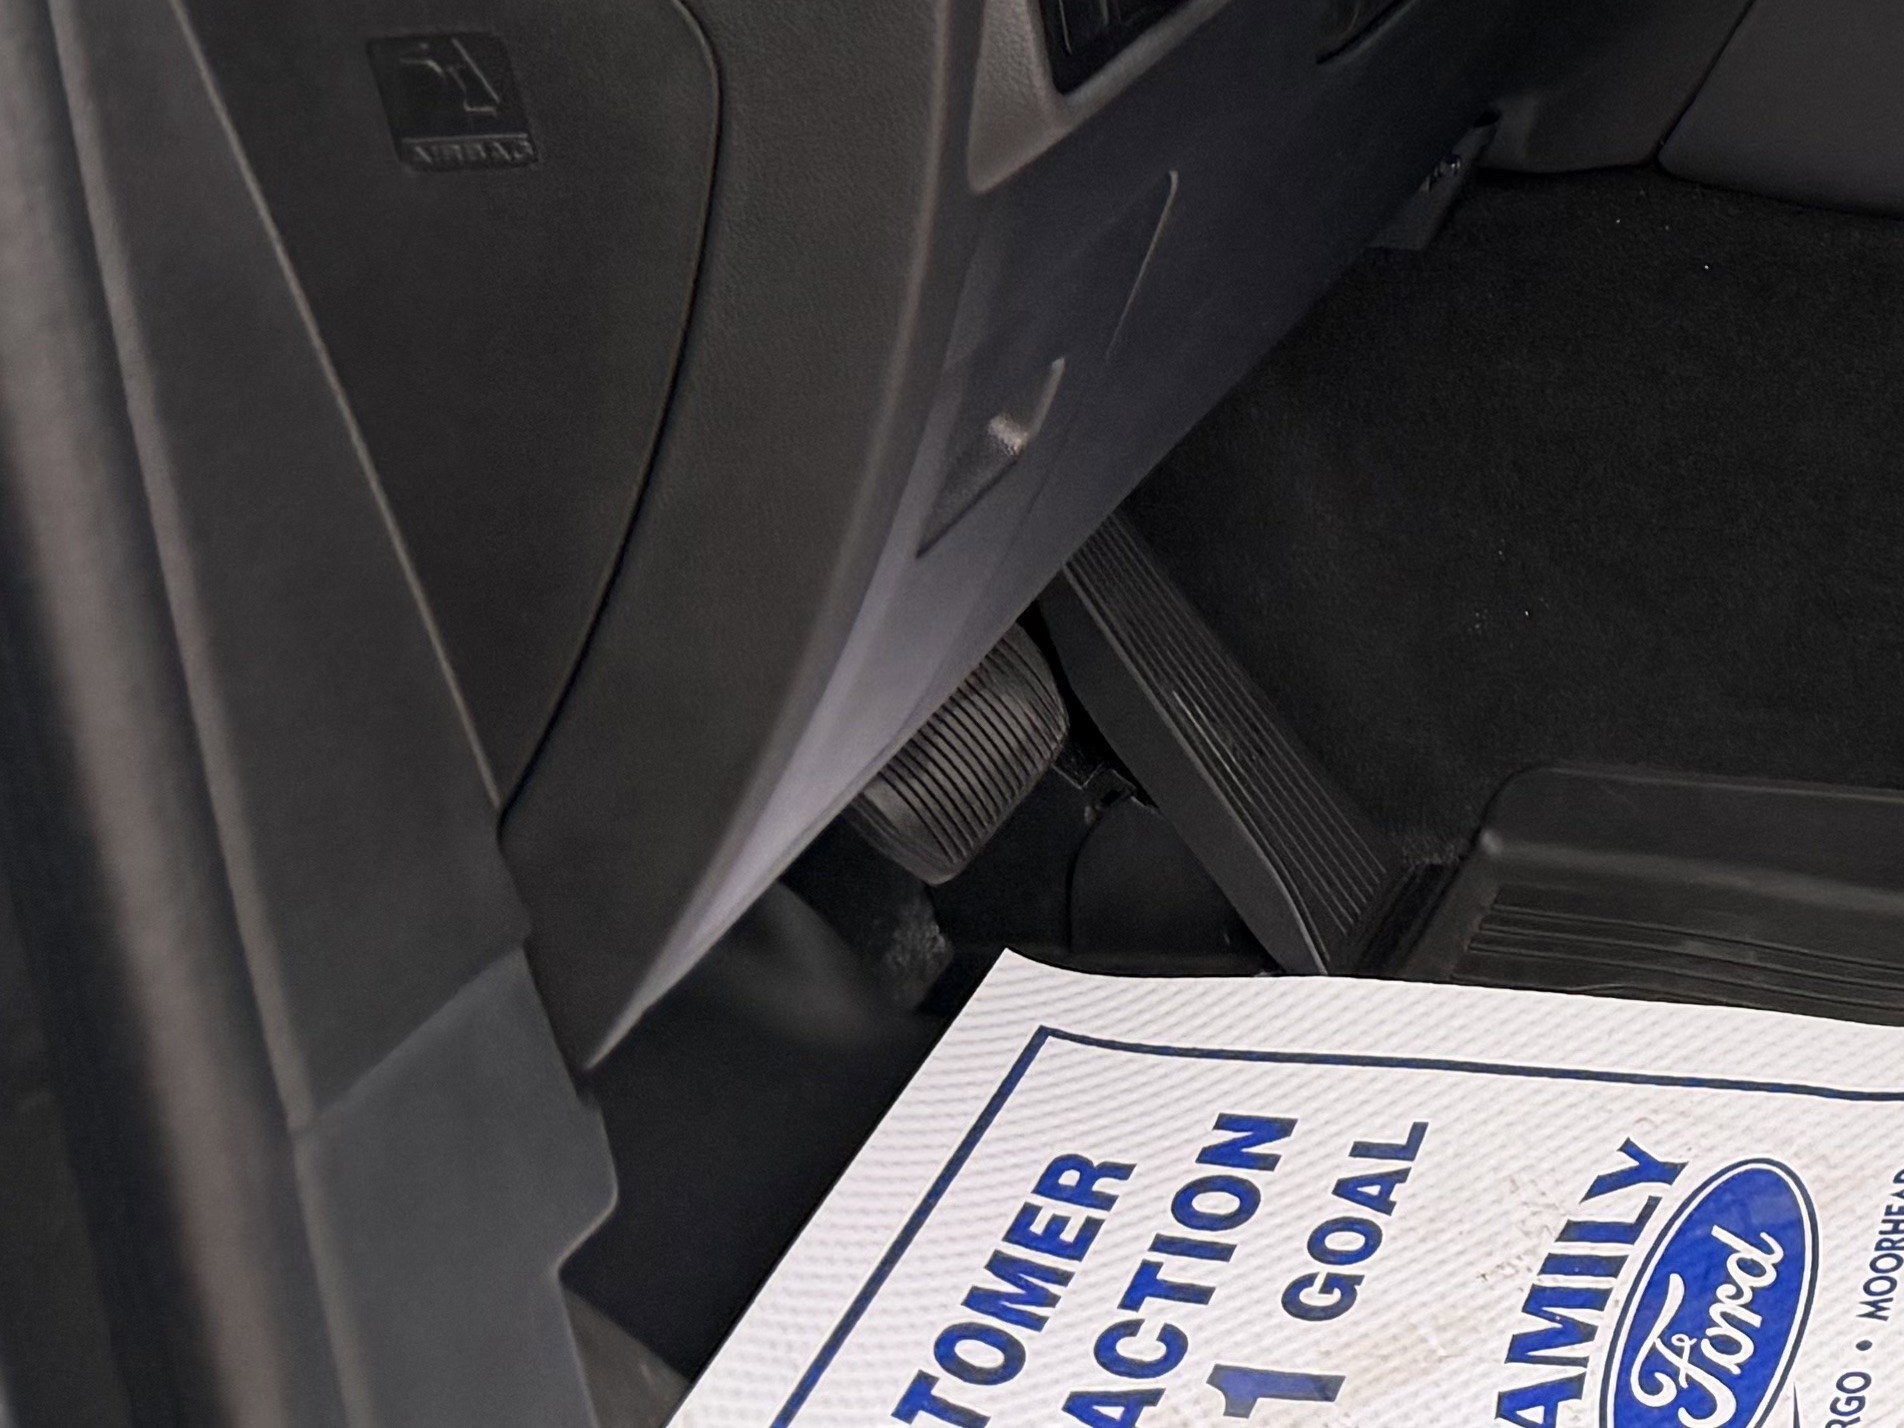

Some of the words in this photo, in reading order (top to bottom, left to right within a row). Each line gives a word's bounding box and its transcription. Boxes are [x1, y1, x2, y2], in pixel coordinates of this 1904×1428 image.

[891, 1152, 1138, 1428] TOMER
[1061, 1112, 1299, 1428] ACTION
[1206, 1363, 1347, 1419] 1
[1281, 1121, 1430, 1322] GOAL
[1494, 1137, 1690, 1428] AMILY
[1630, 1224, 1785, 1428] Ford
